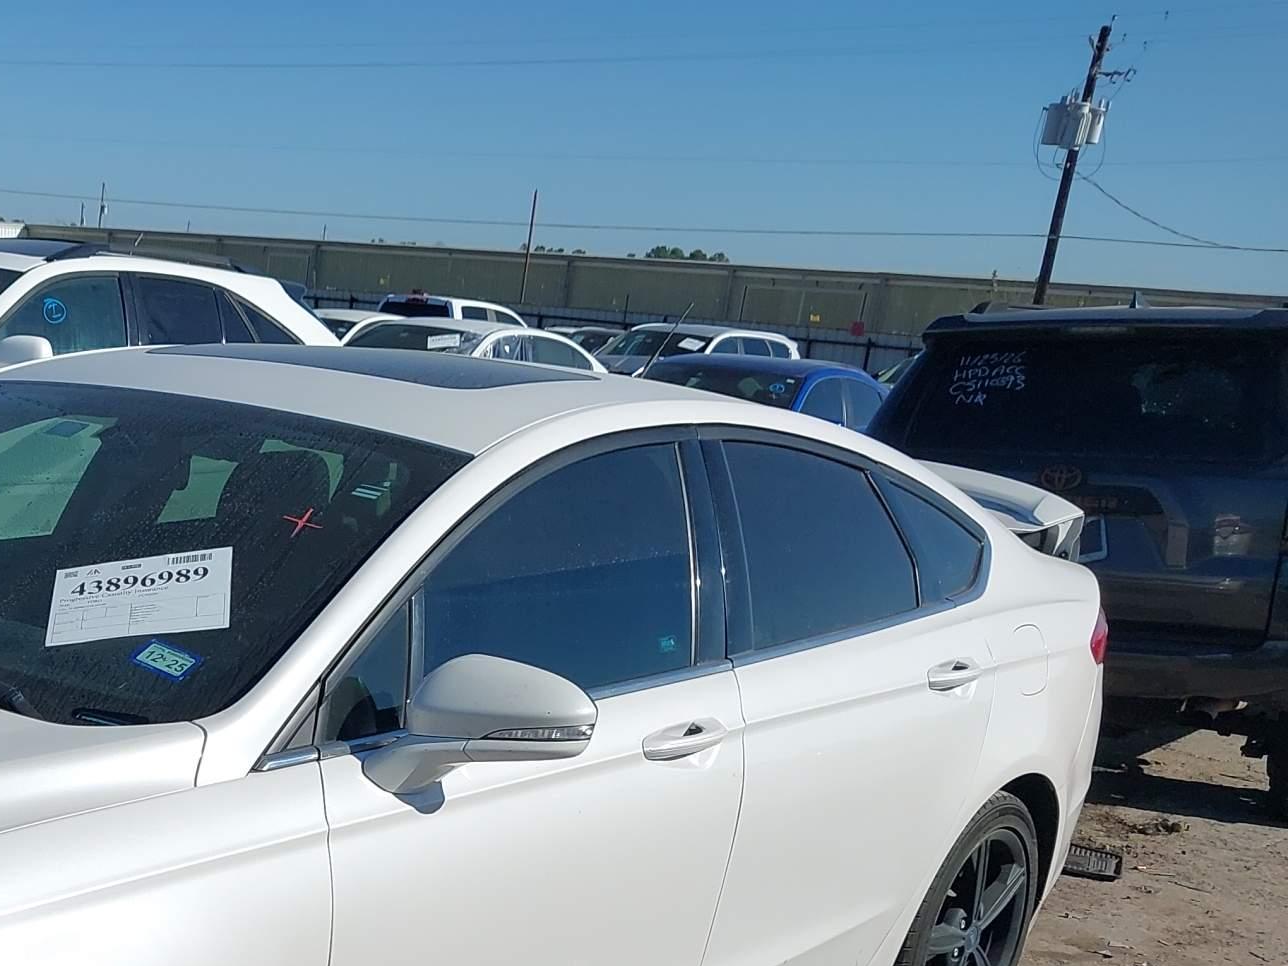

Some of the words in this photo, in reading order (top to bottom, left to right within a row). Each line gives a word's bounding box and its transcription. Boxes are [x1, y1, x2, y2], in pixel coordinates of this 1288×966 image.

[70, 565, 210, 596] 43896989
[145, 650, 164, 663] 12
[165, 659, 188, 673] 25
